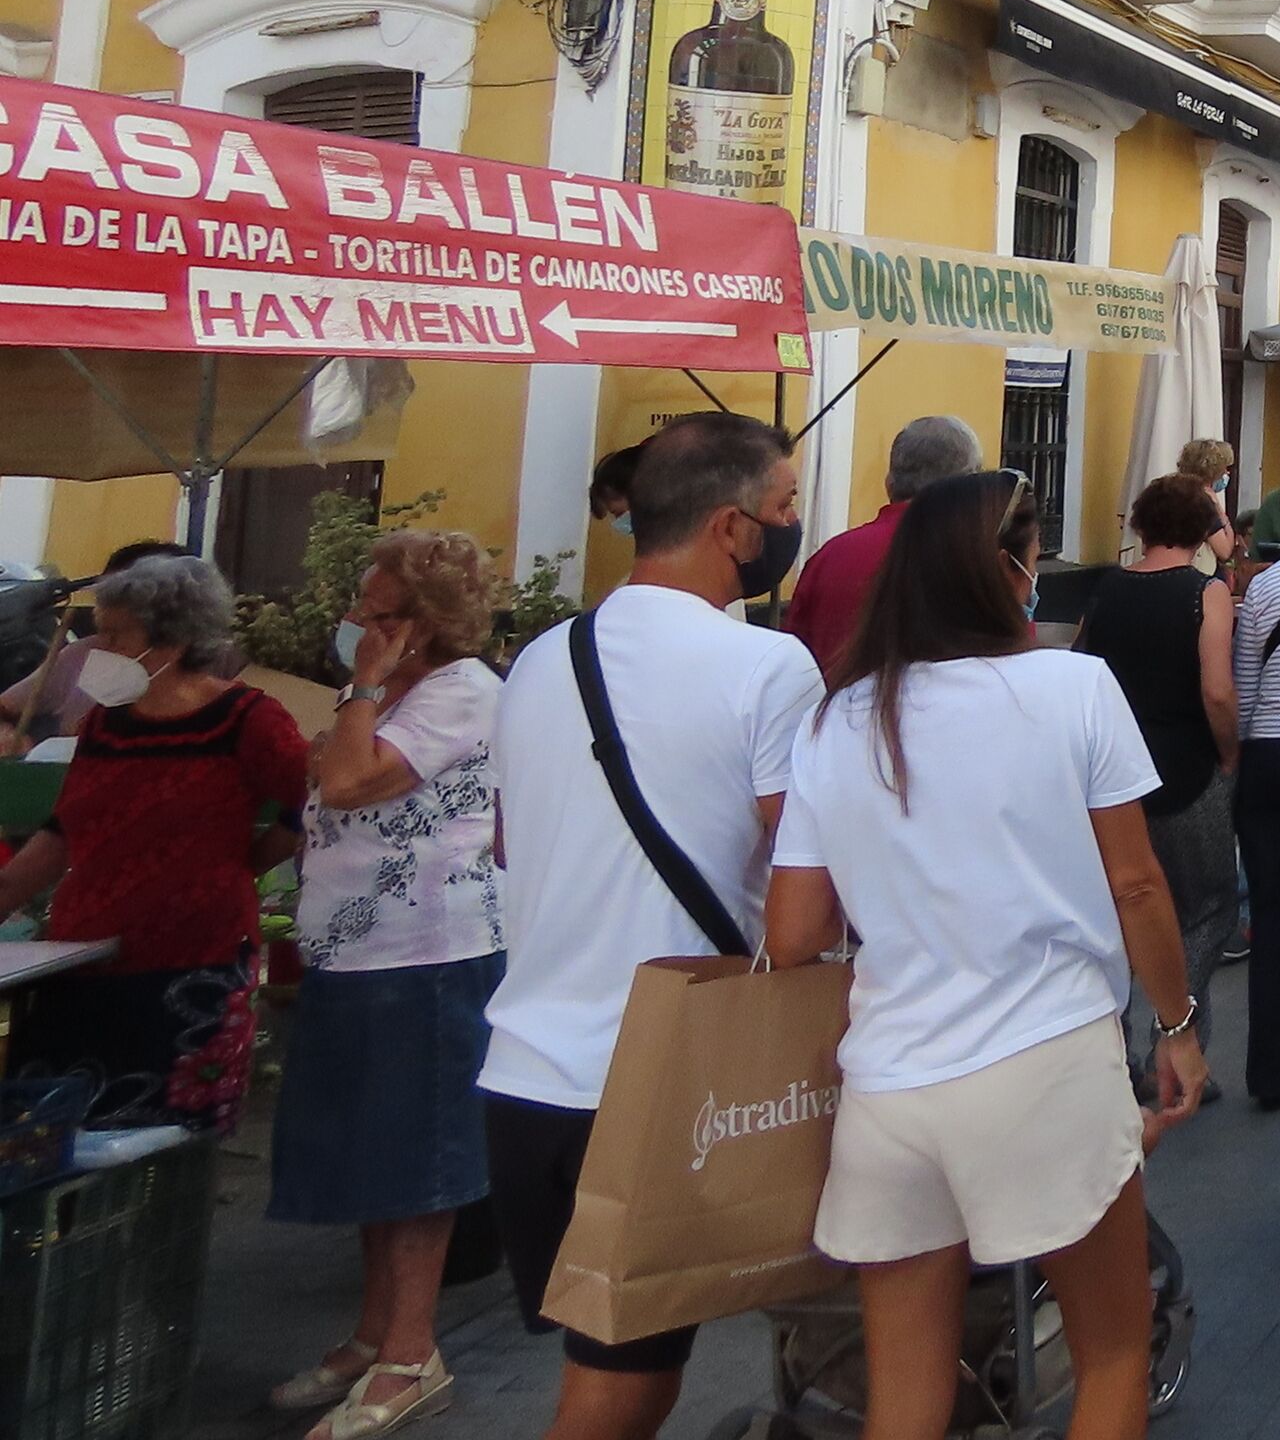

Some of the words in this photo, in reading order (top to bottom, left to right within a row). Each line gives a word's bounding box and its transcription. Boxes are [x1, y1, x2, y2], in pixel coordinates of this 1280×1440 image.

[0, 99, 290, 210] ASA
[317, 144, 659, 252] BALLÉN
[61, 205, 121, 251] DE
[134, 212, 188, 256] LA
[198, 219, 294, 265] TAPA
[484, 249, 522, 285] DE
[529, 254, 690, 299] CAMARONES
[692, 271, 784, 305] CASERAS
[1066, 281, 1093, 297] TLF.
[198, 289, 332, 340] HAY
[357, 297, 527, 347] MENU
[920, 256, 1054, 336] MORENO
[712, 1079, 841, 1143] stradiva
